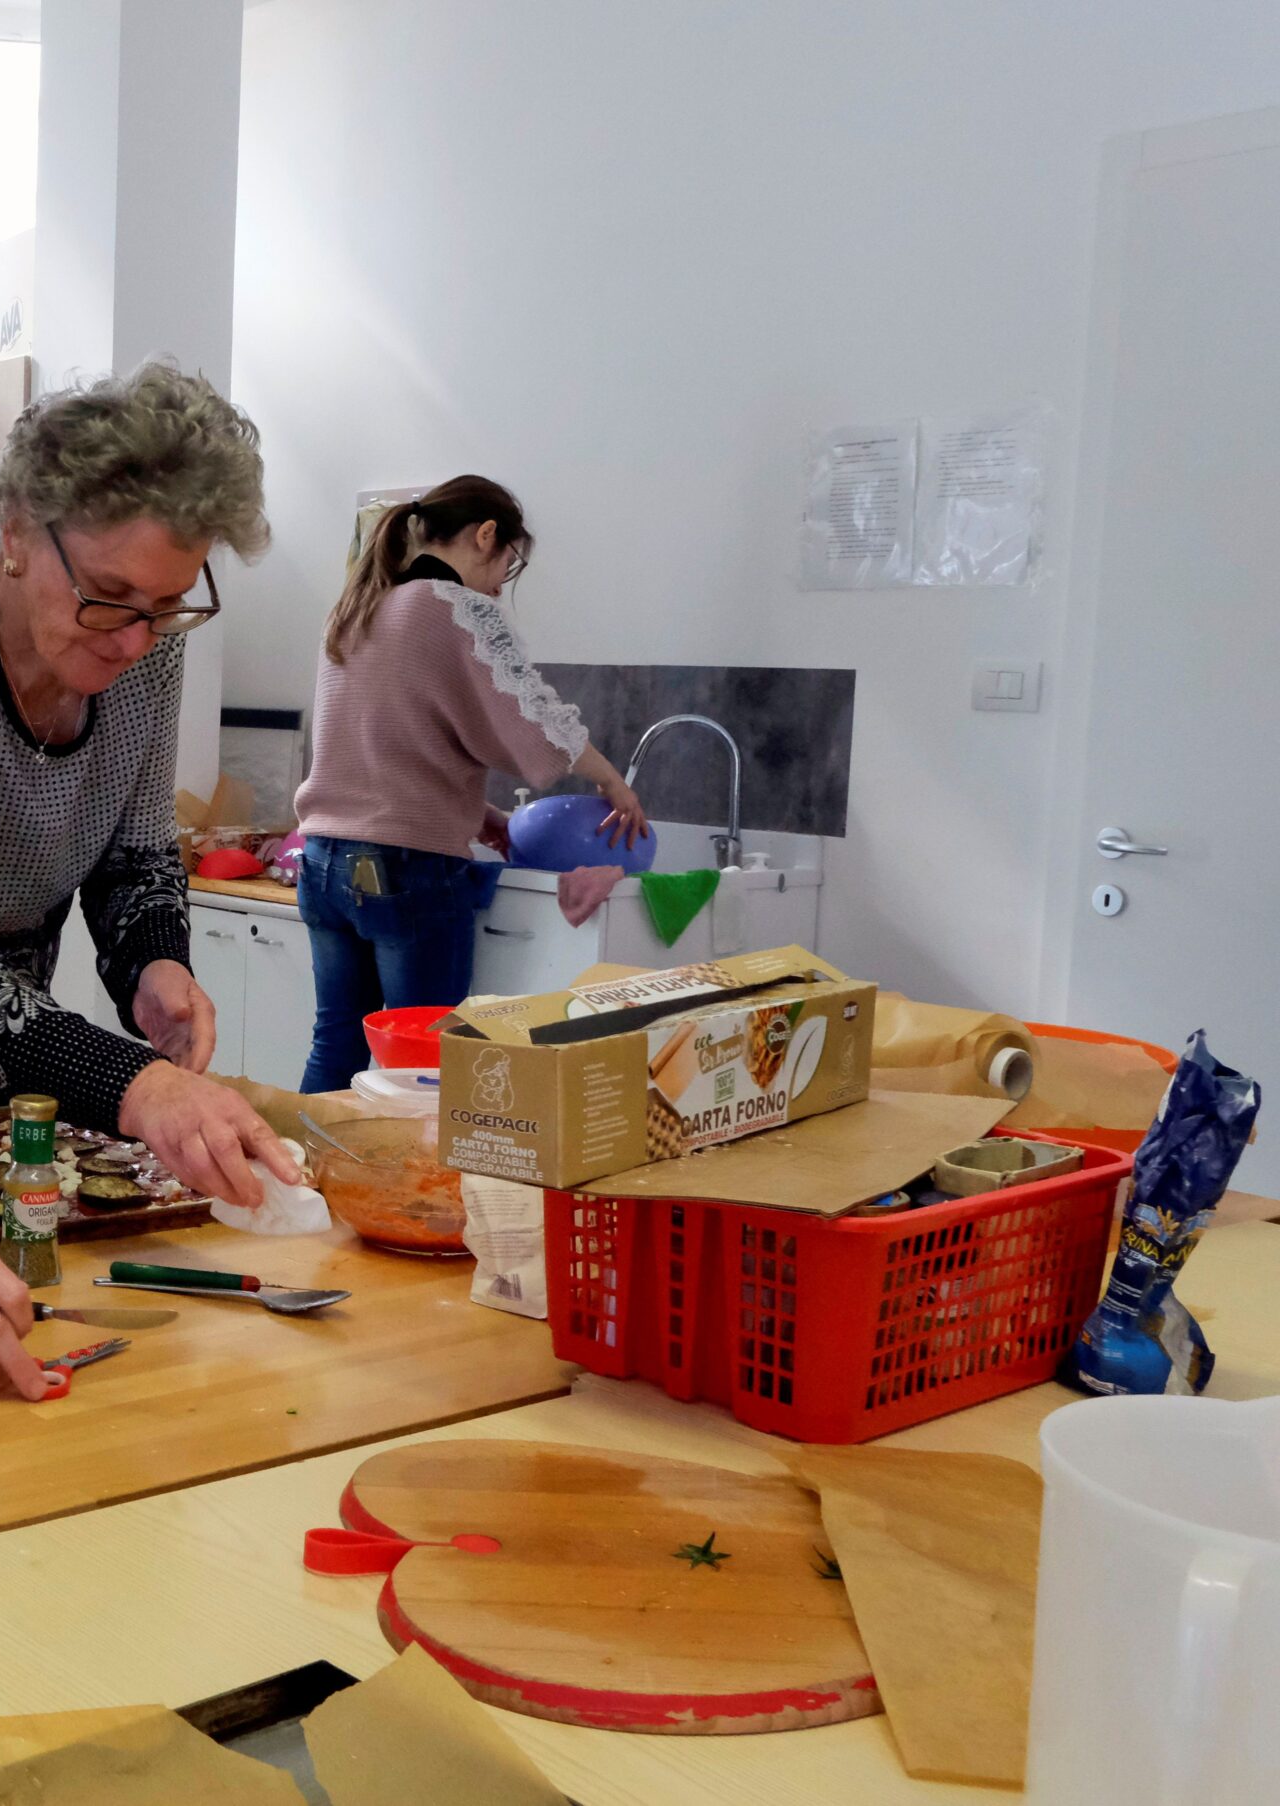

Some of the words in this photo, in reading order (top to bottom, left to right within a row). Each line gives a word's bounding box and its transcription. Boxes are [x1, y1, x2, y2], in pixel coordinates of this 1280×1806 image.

[584, 983, 651, 1006] FORNO
[450, 1109, 540, 1133] COGEPACK
[680, 1105, 731, 1137] CARTA
[736, 1090, 786, 1122] FORNO
[20, 1127, 47, 1141] ERBE
[472, 1130, 514, 1145] 400mm
[452, 1137, 490, 1151] CARTA
[494, 1144, 537, 1159] FORNO
[452, 1147, 537, 1169] COMPOSTABILE
[447, 1156, 544, 1181] BIODEGRADABILE
[28, 1206, 57, 1217] ORIGAN
